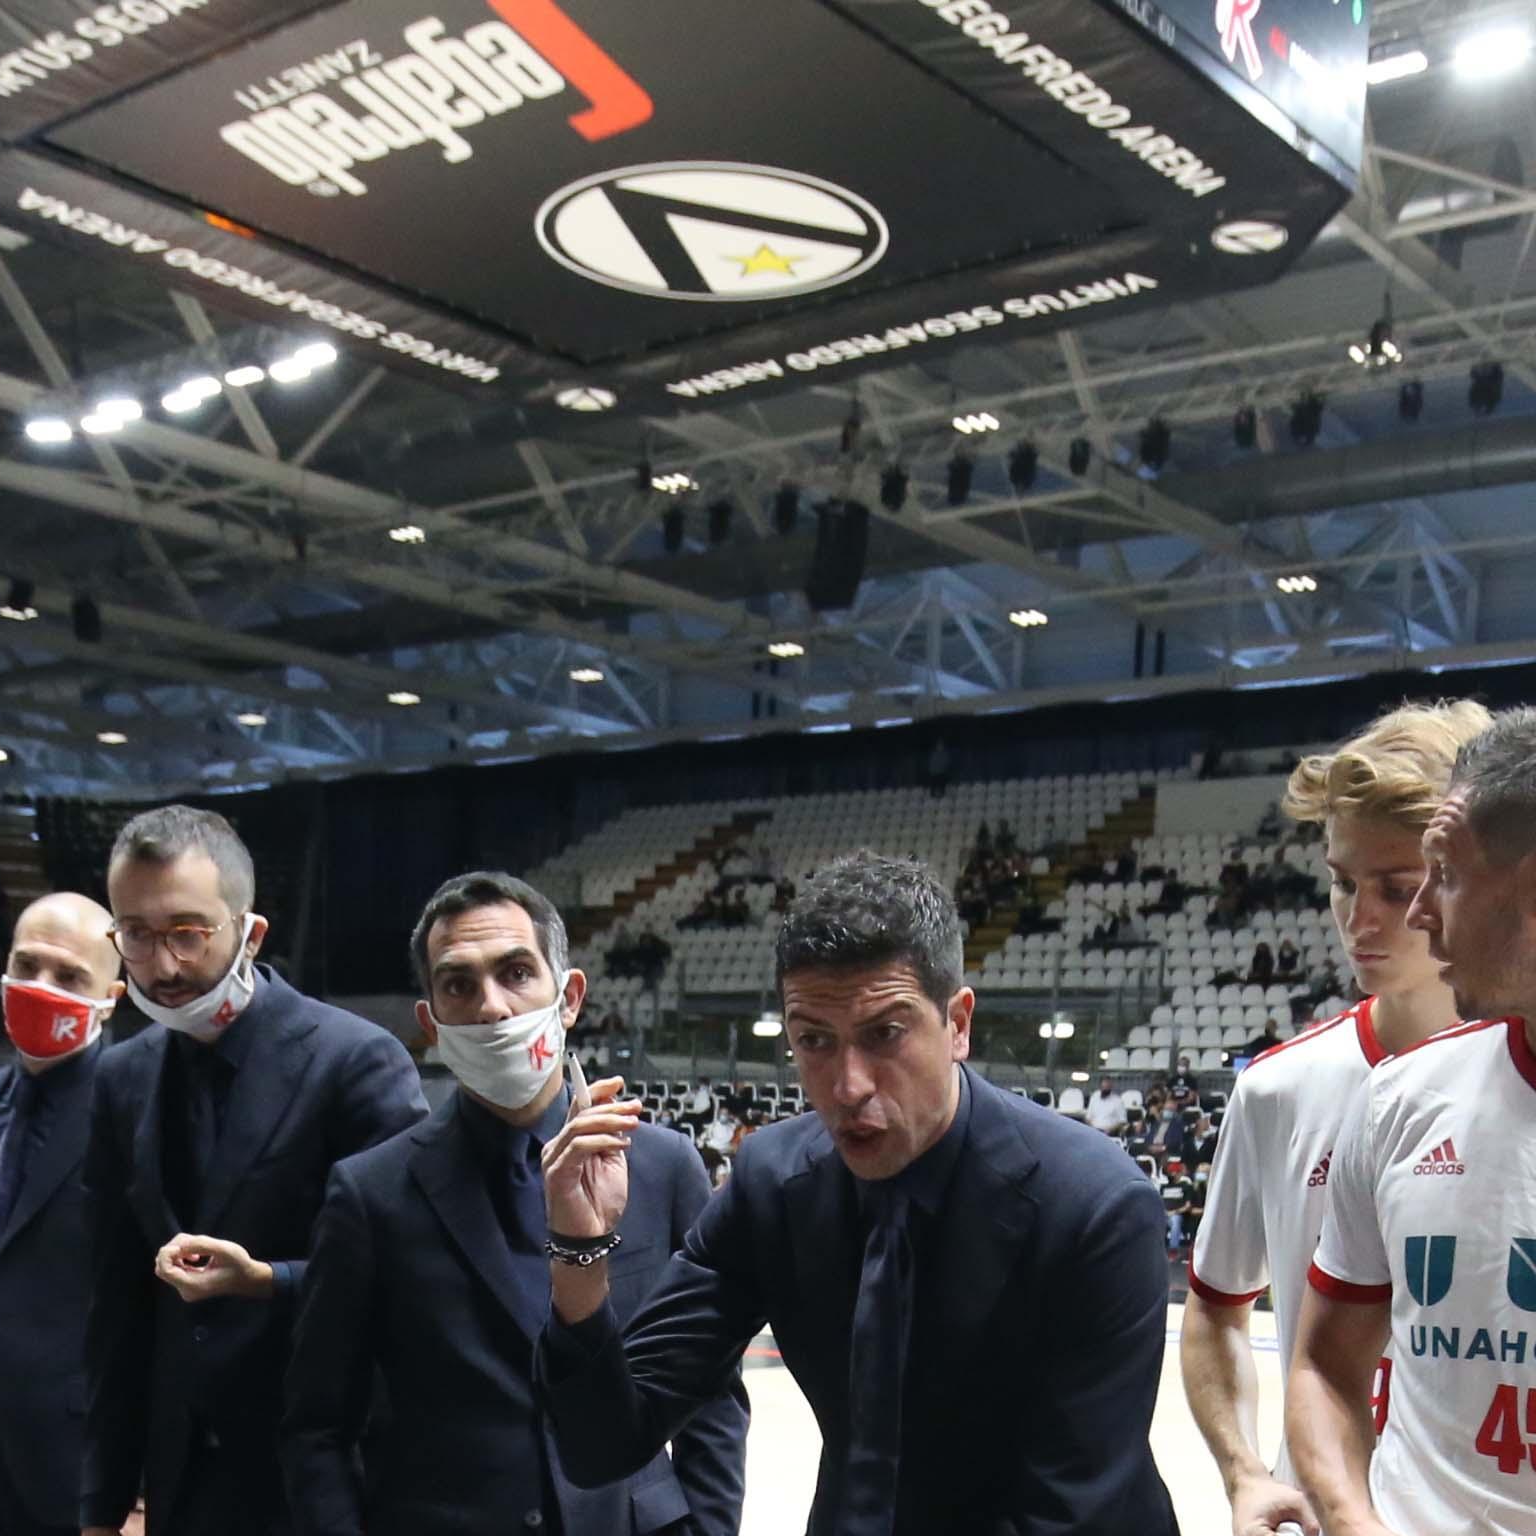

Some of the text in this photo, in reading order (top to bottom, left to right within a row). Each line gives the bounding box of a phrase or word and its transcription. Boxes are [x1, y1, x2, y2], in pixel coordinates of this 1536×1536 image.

[234, 39, 383, 111] ZANETTI
[919, 0, 1226, 198] EGAFREDO ARENA
[17, 187, 167, 254] ARENA
[666, 272, 1158, 398] VIRTUS SEGAFREDO ARENA
[1413, 1160, 1465, 1176] adidas
